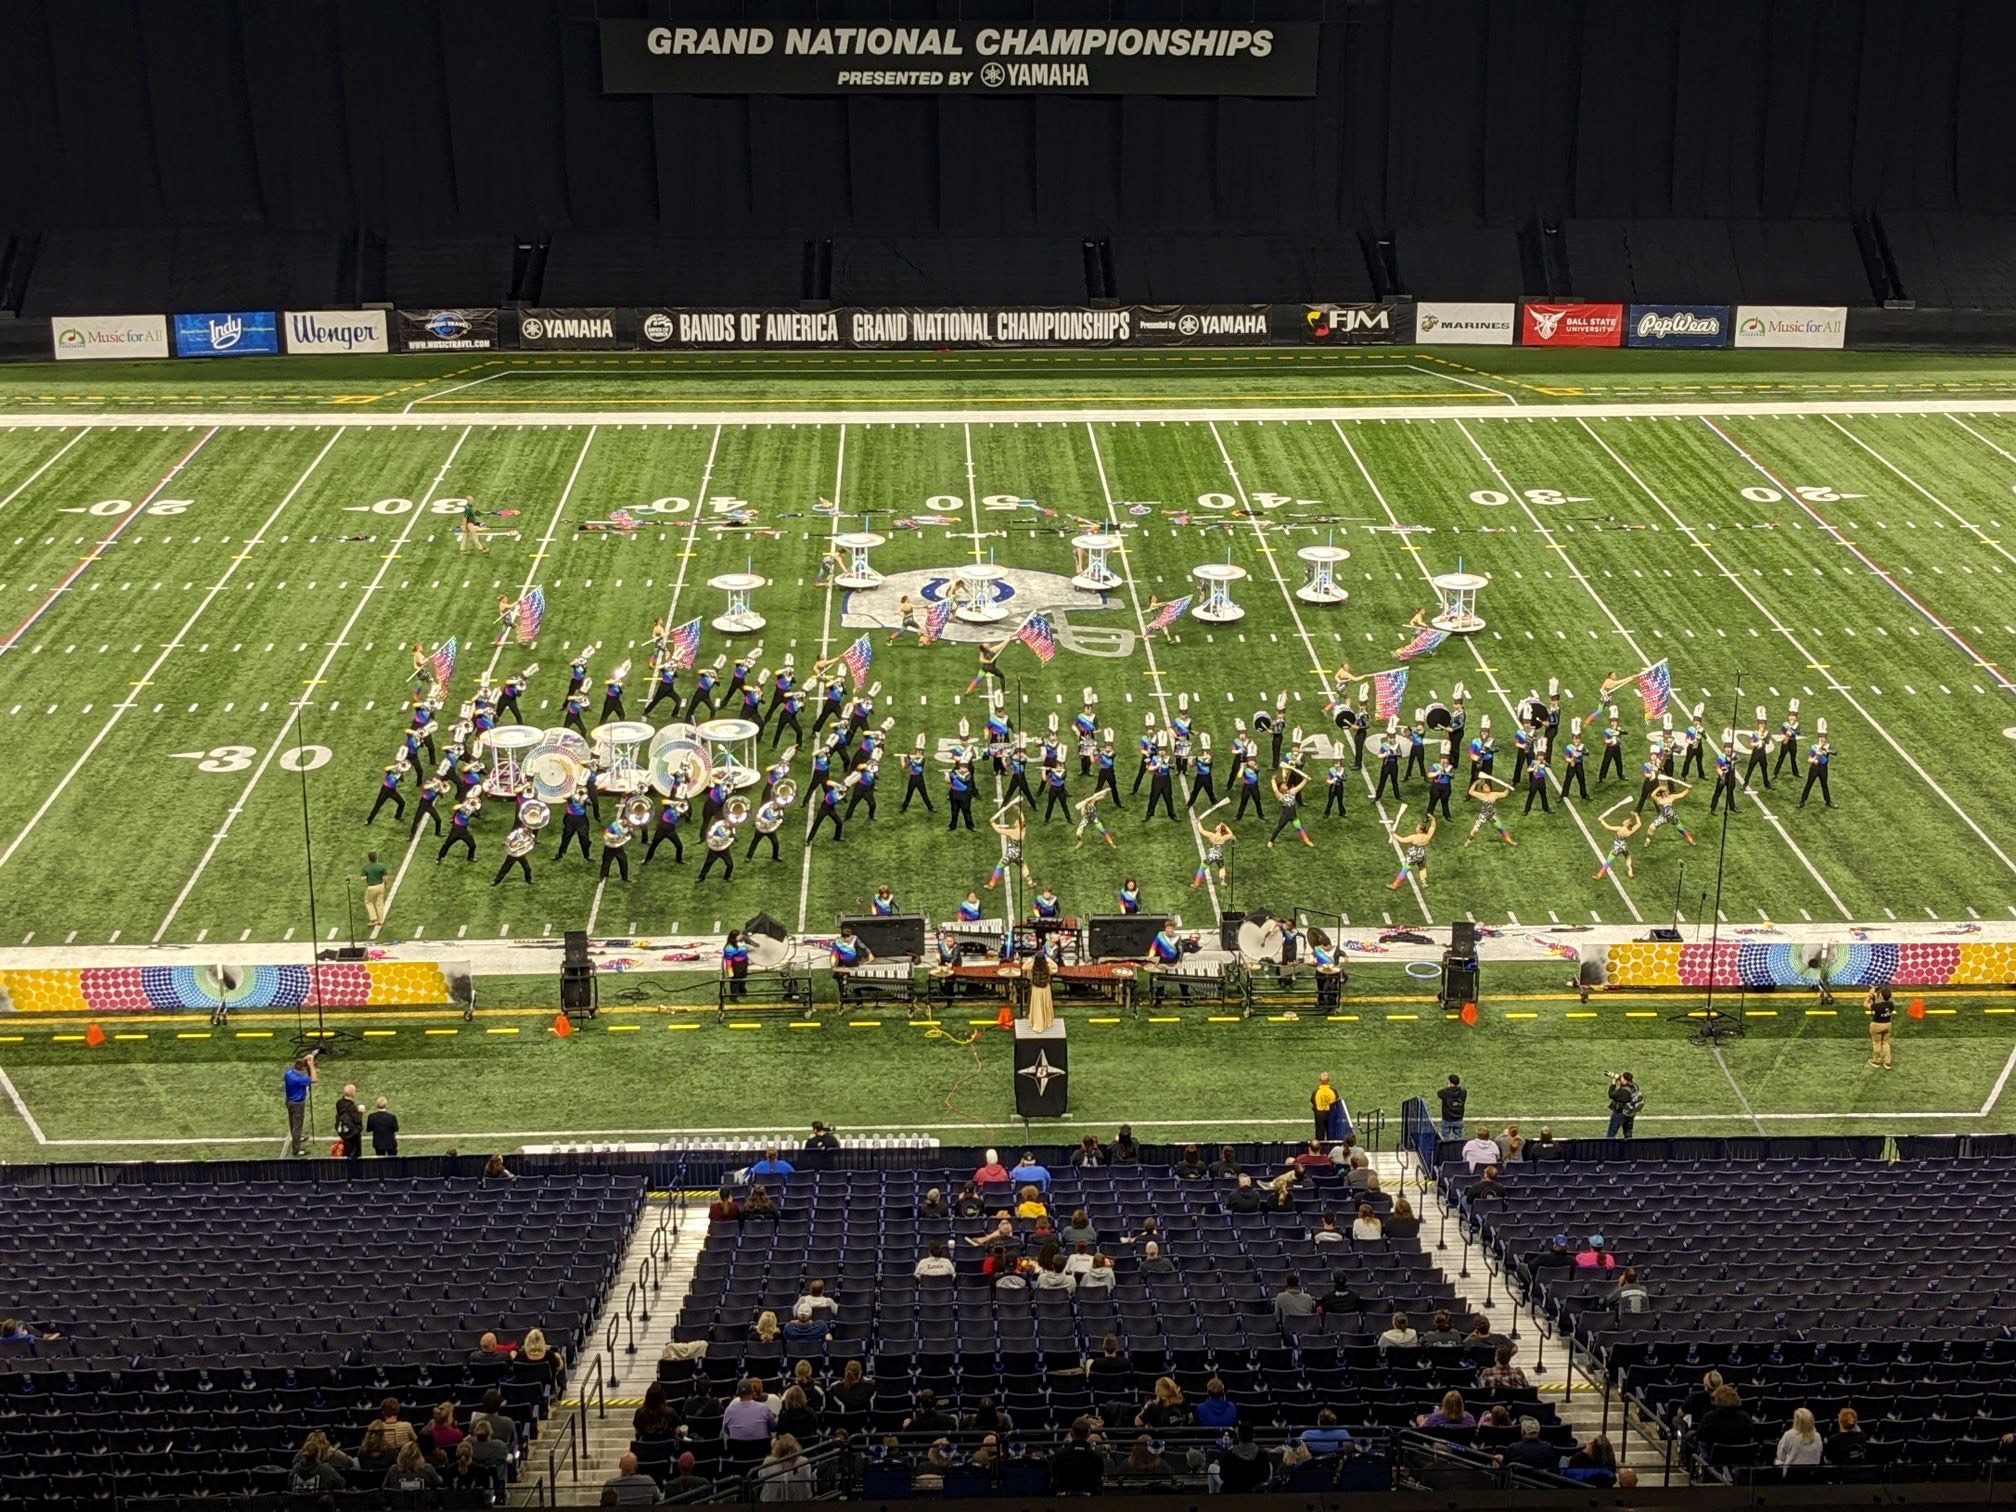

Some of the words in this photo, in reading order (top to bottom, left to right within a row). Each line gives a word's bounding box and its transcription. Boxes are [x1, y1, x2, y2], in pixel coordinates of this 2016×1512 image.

[647, 27, 774, 55] GRAND
[785, 28, 963, 55] NATIONAL
[976, 28, 1274, 57] CHAMPIONSHIPS
[838, 71, 943, 86] PRESENTED
[948, 71, 974, 86] BY
[1007, 63, 1090, 86] YAMAHA
[209, 314, 241, 349] Indy
[293, 314, 379, 349] Wenger
[544, 319, 613, 338] YAMAHA
[680, 314, 736, 342] BANDS
[740, 313, 761, 342] OF
[766, 313, 838, 342] AMERICA
[853, 313, 907, 342] GRAND
[913, 313, 993, 341] NATIONAL
[997, 312, 1131, 341] CHAMPIONSHIPS
[1200, 315, 1267, 334] YAMAHA
[1329, 310, 1389, 332] FJM
[1441, 322, 1510, 330] MARINES
[1566, 317, 1588, 325] BALL
[1590, 317, 1616, 326] STATE
[1639, 313, 1719, 338] PepWear
[1768, 320, 1804, 333] Music
[1805, 320, 1823, 333] for
[1823, 321, 1841, 333] All
[88, 331, 125, 343] Music
[126, 331, 144, 343] for
[144, 330, 163, 343] All
